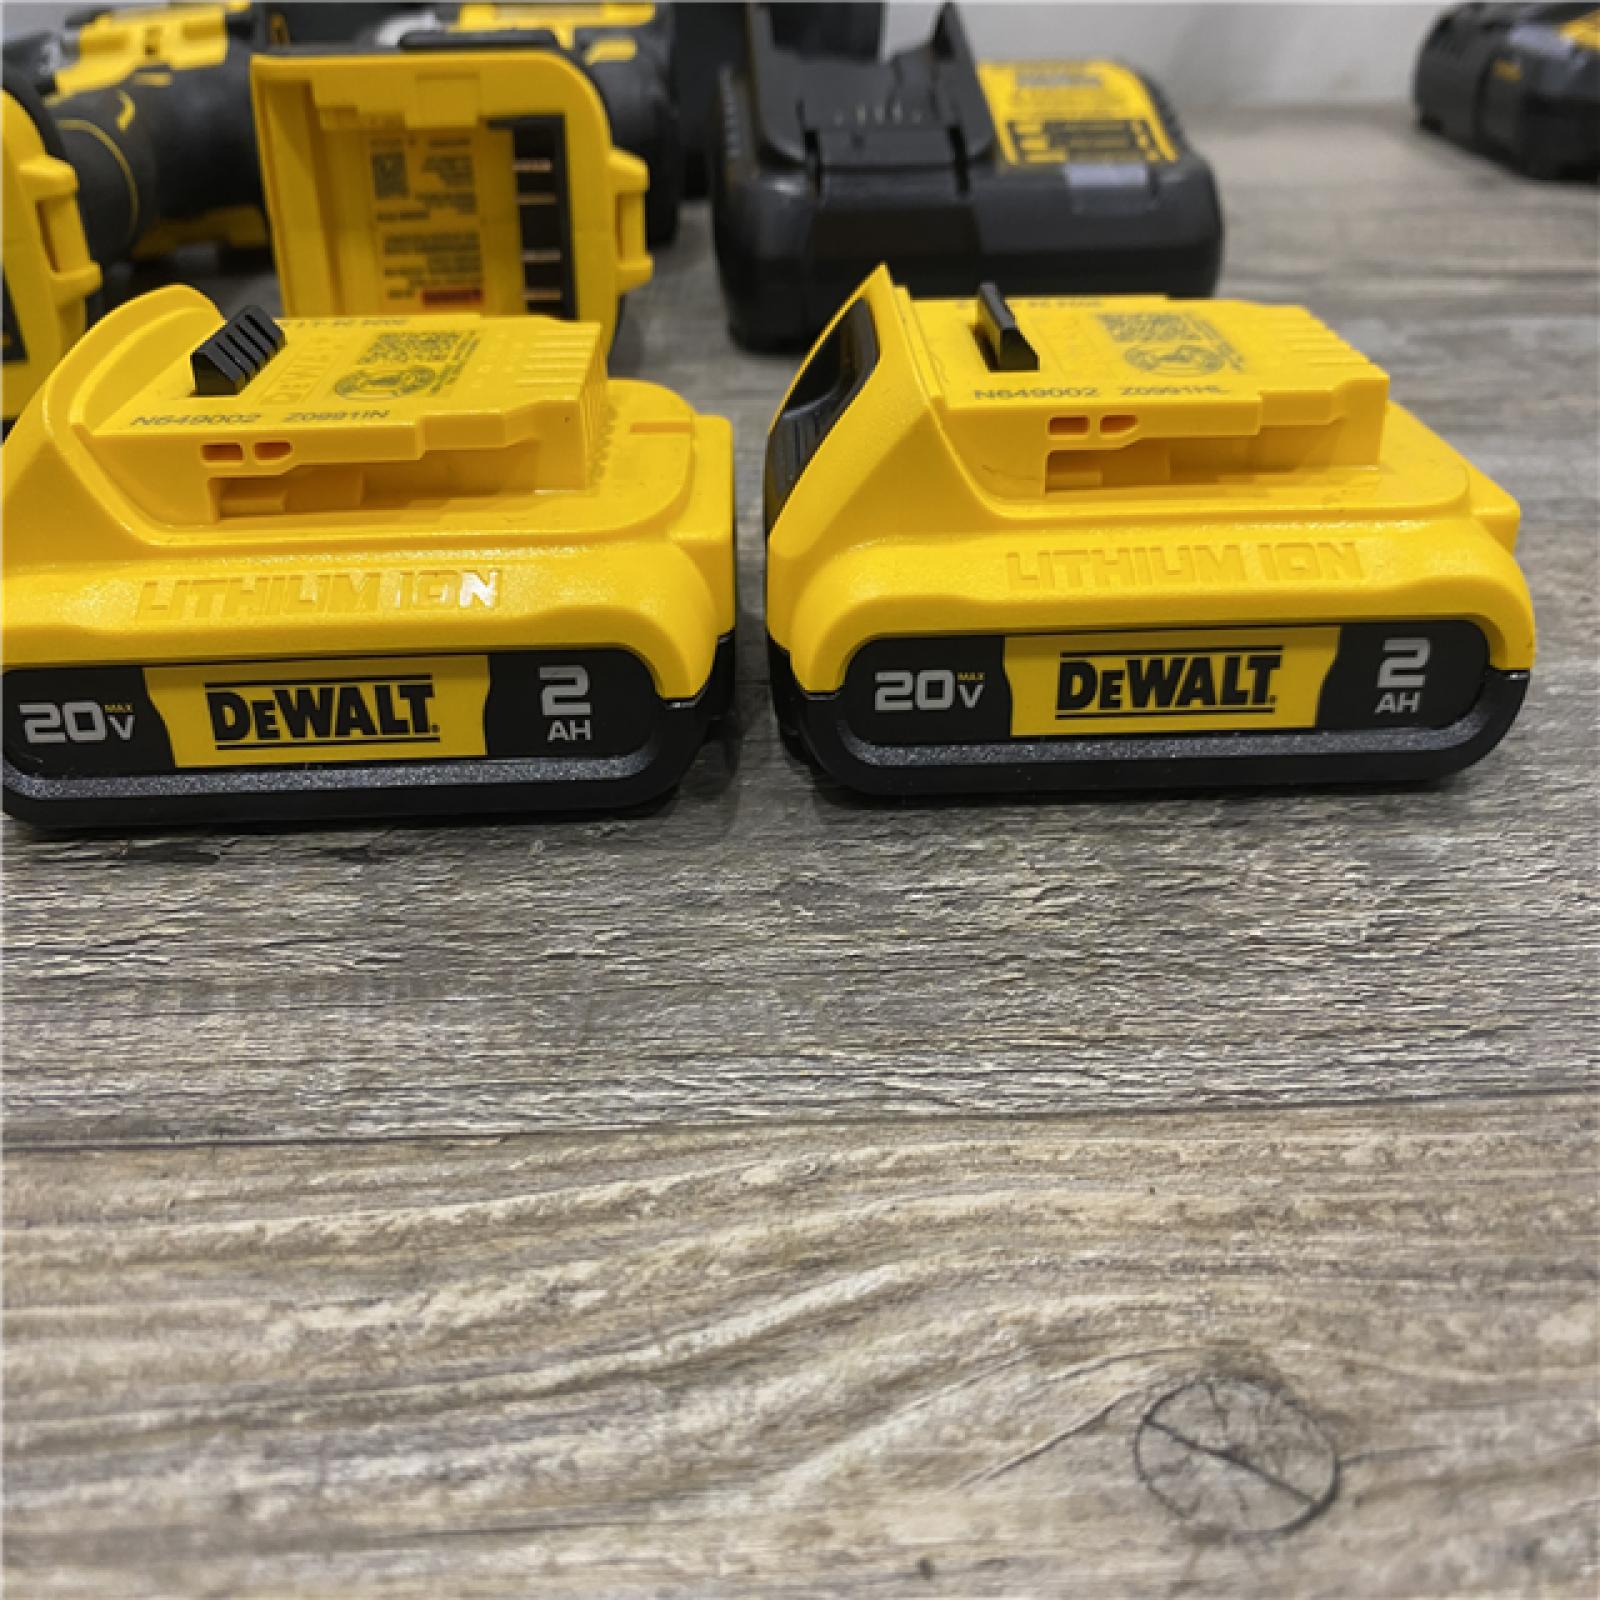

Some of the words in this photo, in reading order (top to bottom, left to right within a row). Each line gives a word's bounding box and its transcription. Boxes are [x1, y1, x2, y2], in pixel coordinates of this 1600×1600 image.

[1004, 543, 1247, 589] LITHIUM
[1256, 541, 1365, 581] ION
[135, 572, 381, 620] LITHIUM
[396, 568, 501, 609] ION
[1377, 637, 1431, 689] 2
[539, 664, 592, 716] 2
[1375, 691, 1421, 714] AH
[547, 719, 592, 742] AH
